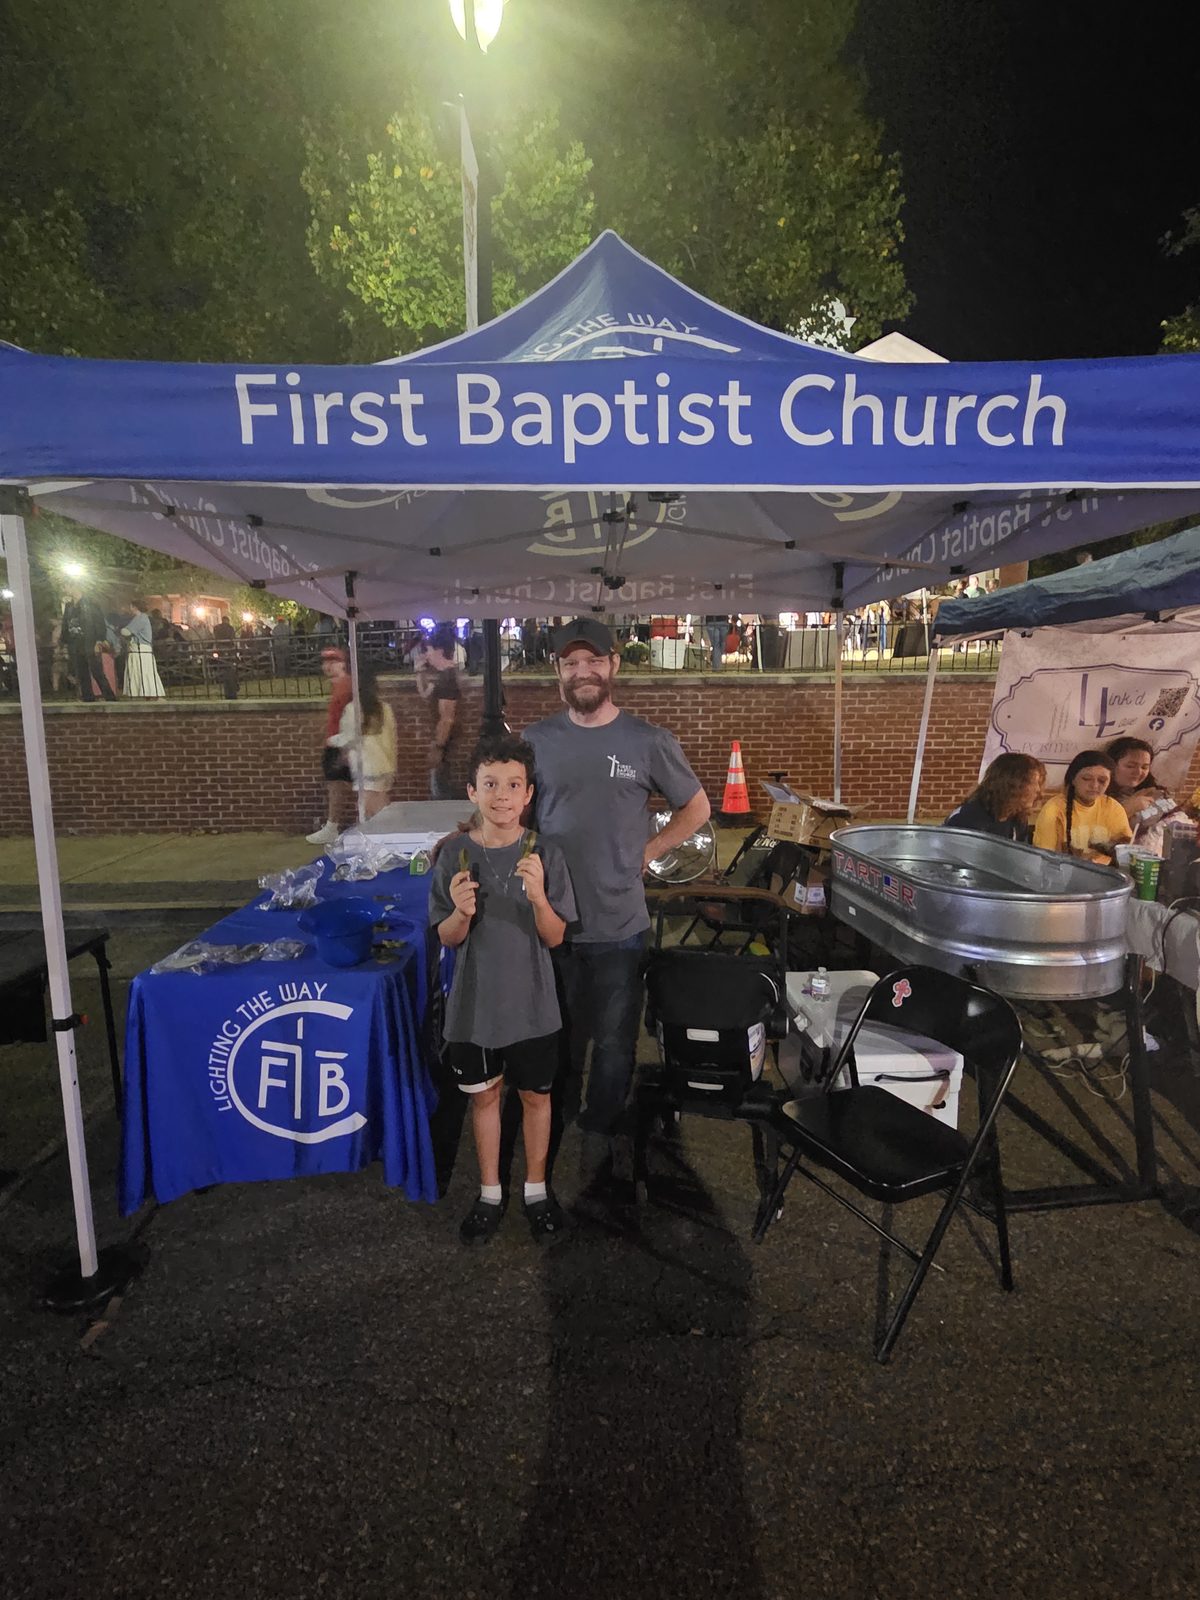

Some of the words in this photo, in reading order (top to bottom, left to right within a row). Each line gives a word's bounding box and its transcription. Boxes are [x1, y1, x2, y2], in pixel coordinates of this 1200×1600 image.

[560, 313, 619, 338] THE
[627, 312, 699, 334] WAY
[235, 372, 427, 447] First
[456, 371, 753, 465] Baptist
[780, 373, 1067, 447] Church
[208, 1020, 241, 1111] LIGHTING
[236, 991, 275, 1020] THE
[279, 982, 328, 1001] WAY
